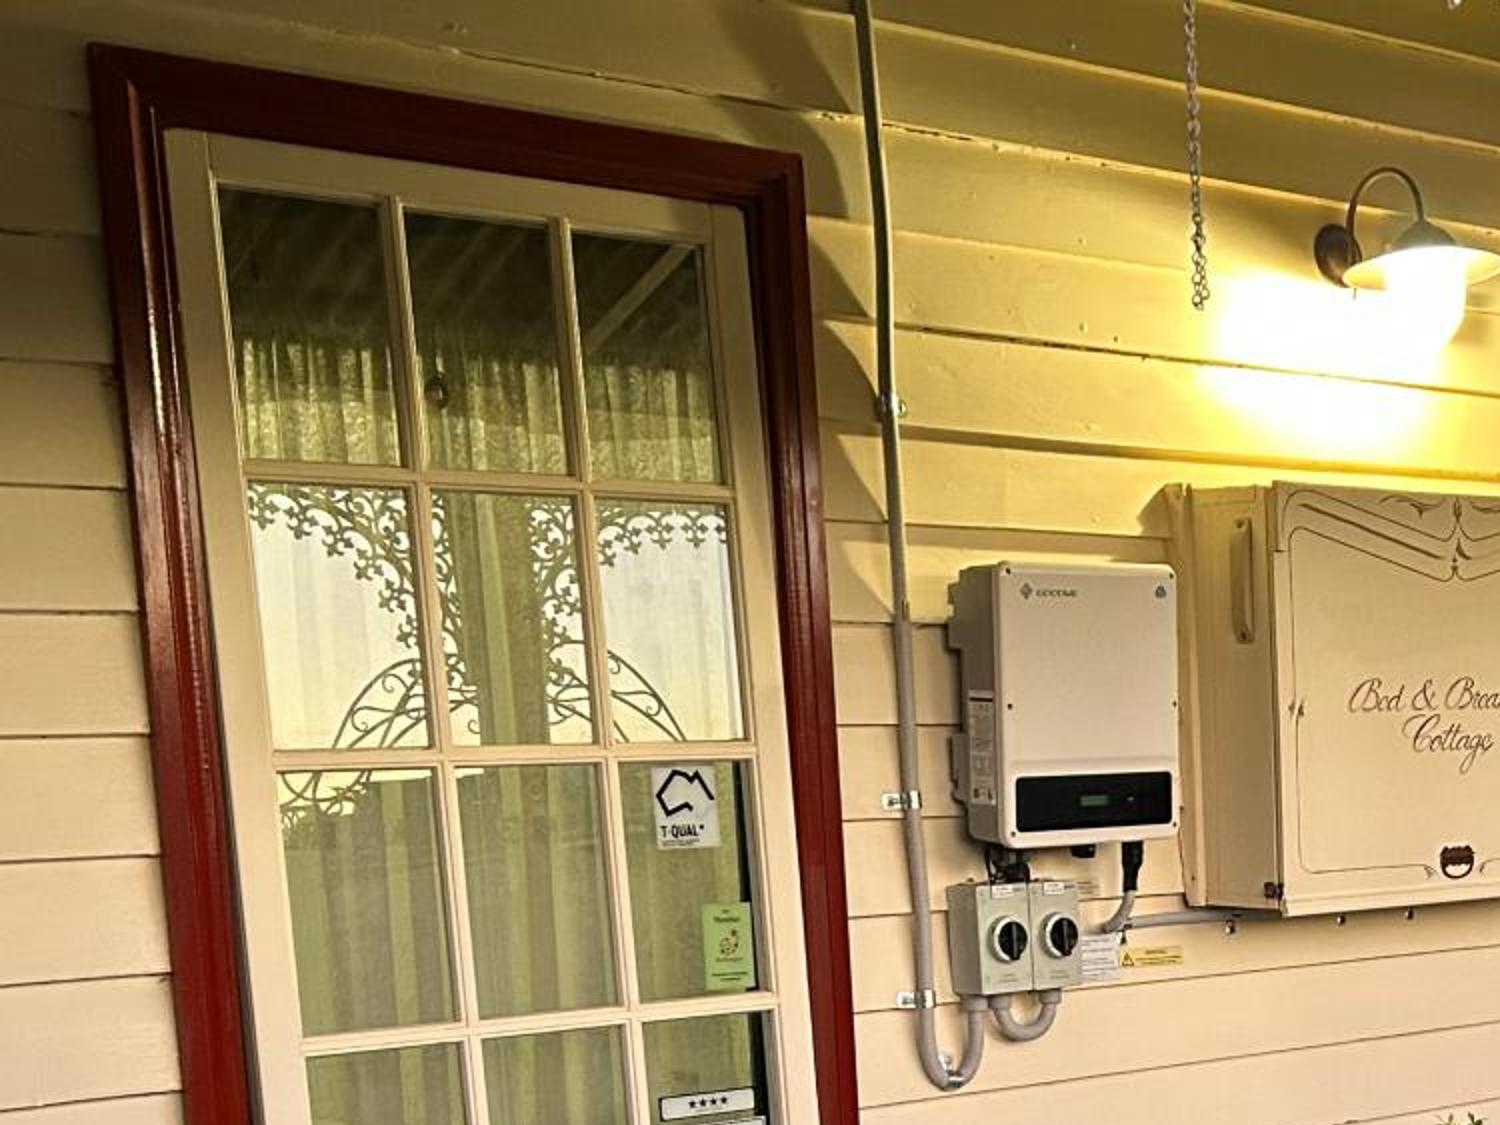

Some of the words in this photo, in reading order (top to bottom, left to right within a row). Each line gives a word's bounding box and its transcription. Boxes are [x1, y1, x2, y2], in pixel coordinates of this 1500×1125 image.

[1349, 677, 1405, 713] Bed
[1411, 679, 1439, 711] &
[1402, 713, 1494, 774] Cottage
